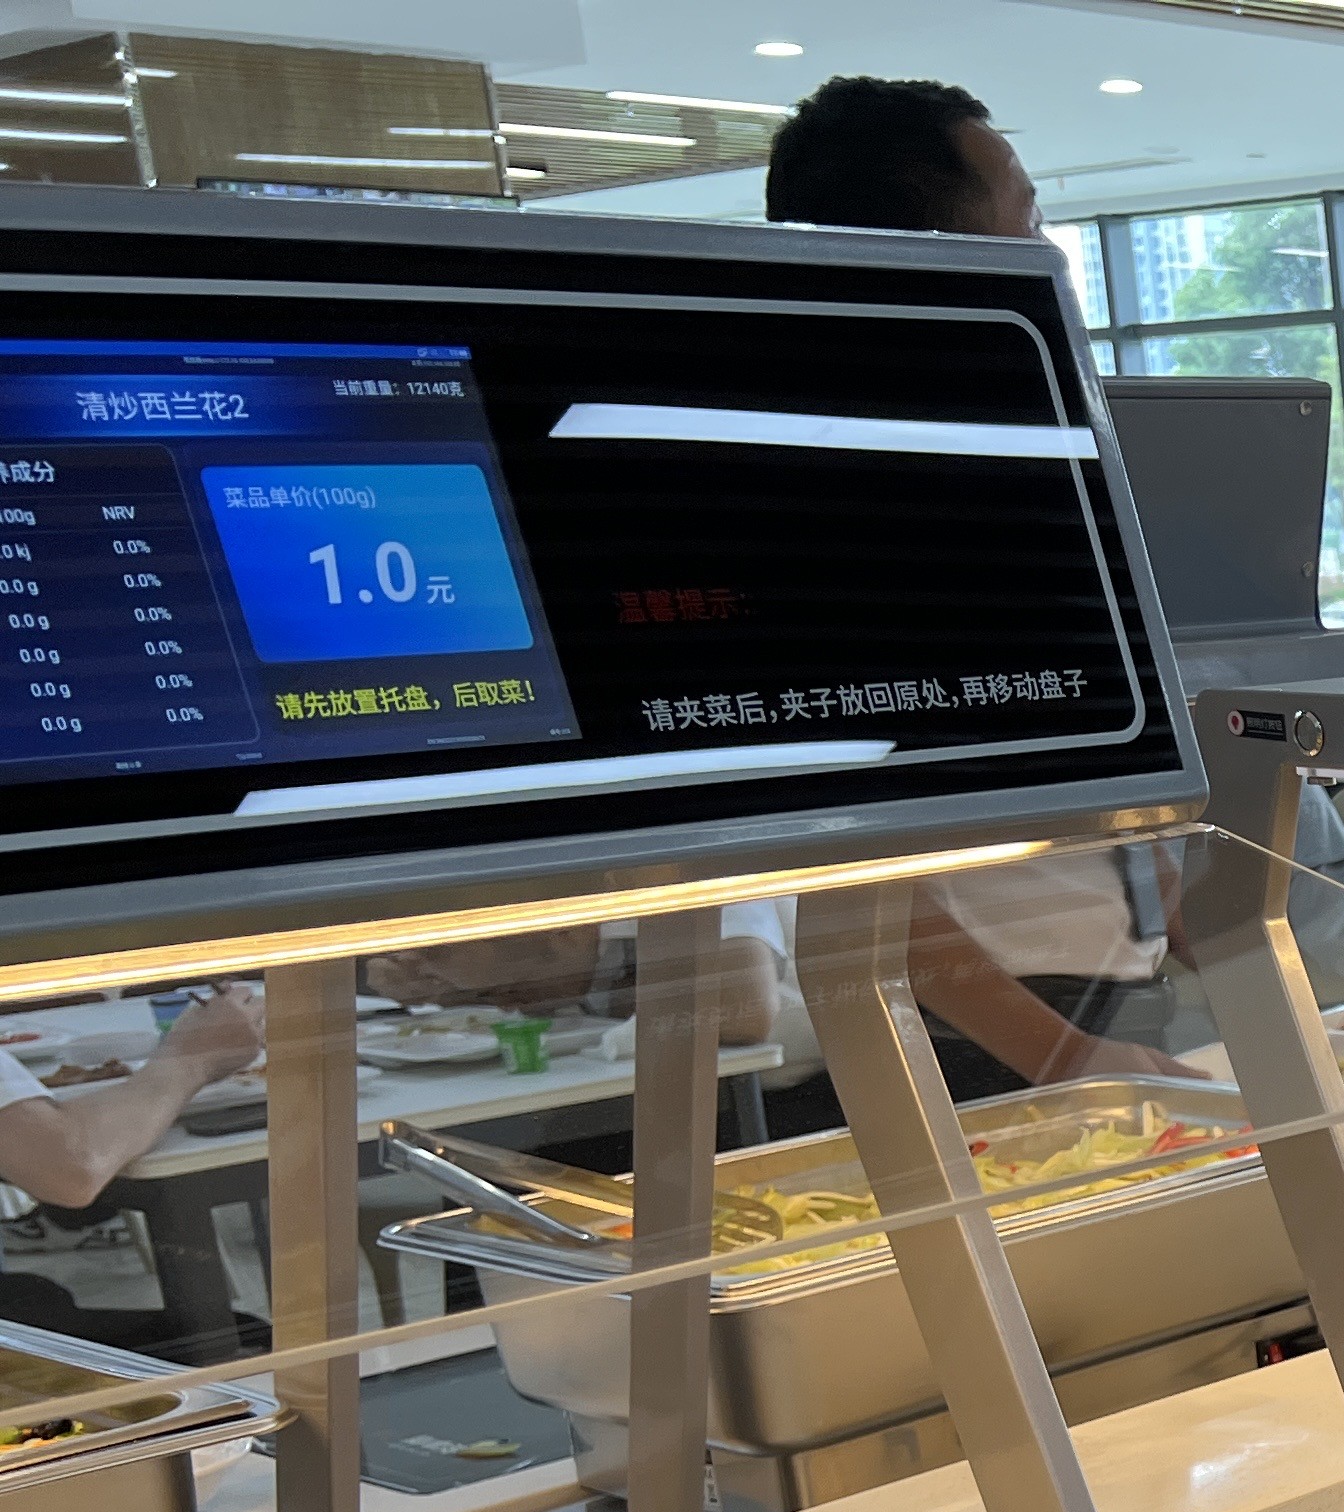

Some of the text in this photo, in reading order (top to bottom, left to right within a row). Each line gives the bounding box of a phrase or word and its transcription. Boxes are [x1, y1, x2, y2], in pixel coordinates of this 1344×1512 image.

[76, 391, 249, 422] 清炒西兰花2
[223, 485, 377, 510] 菜品单价(100g)
[102, 505, 135, 521] NRV
[112, 539, 151, 555] 0.0%
[123, 572, 162, 588] 0.0%
[134, 606, 172, 622] 0.0%
[144, 640, 183, 656] 0.0%
[155, 673, 193, 690] 0.0%
[166, 706, 204, 723] 0.0%
